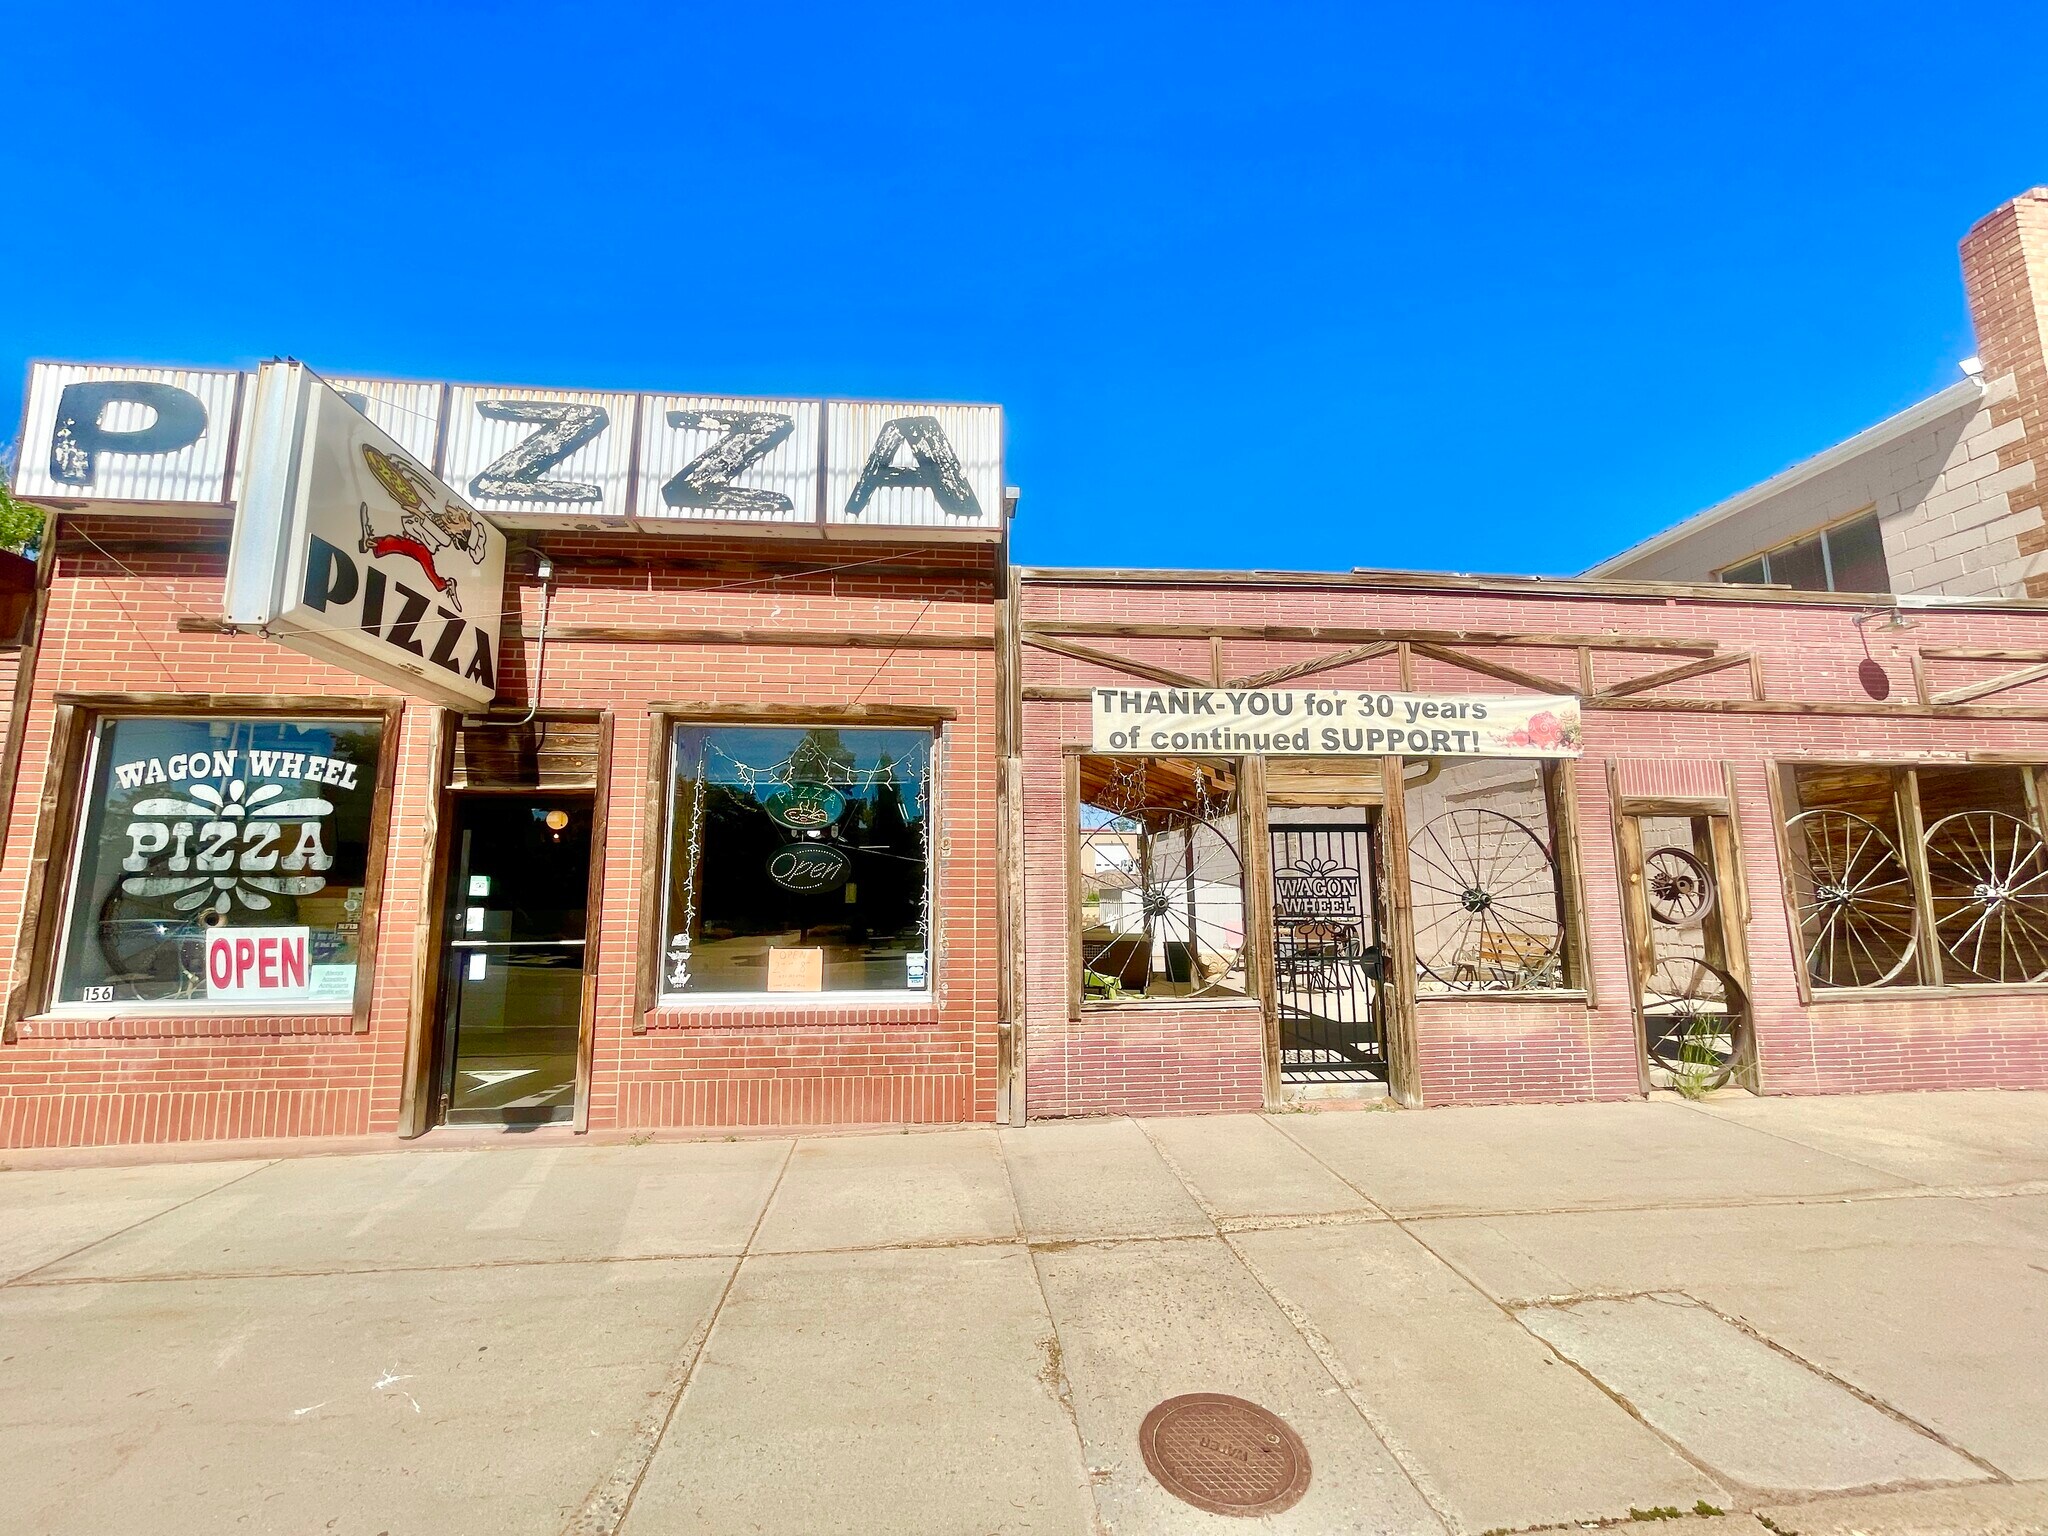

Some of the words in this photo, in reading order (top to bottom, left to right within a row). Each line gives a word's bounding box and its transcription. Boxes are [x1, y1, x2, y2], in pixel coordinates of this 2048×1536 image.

[50, 381, 984, 518] PZZA
[303, 533, 495, 690] PIZZA
[1097, 689, 1294, 717] THANK-YOU
[1304, 693, 1347, 717] for
[1357, 694, 1395, 718] 30
[1404, 697, 1488, 724] years
[1109, 727, 1141, 750] of
[1150, 726, 1310, 752] continued
[1321, 729, 1480, 754] SUPPORT!
[115, 750, 238, 790] WAGON
[249, 750, 359, 791] WHEEL
[776, 787, 836, 808] PIZZA
[122, 822, 334, 872] PIZZA
[771, 853, 843, 882] Open
[1278, 878, 1356, 897] WAGON
[1283, 898, 1356, 914] WHEEL
[210, 937, 305, 989] OPEN
[84, 988, 111, 1000] 156
